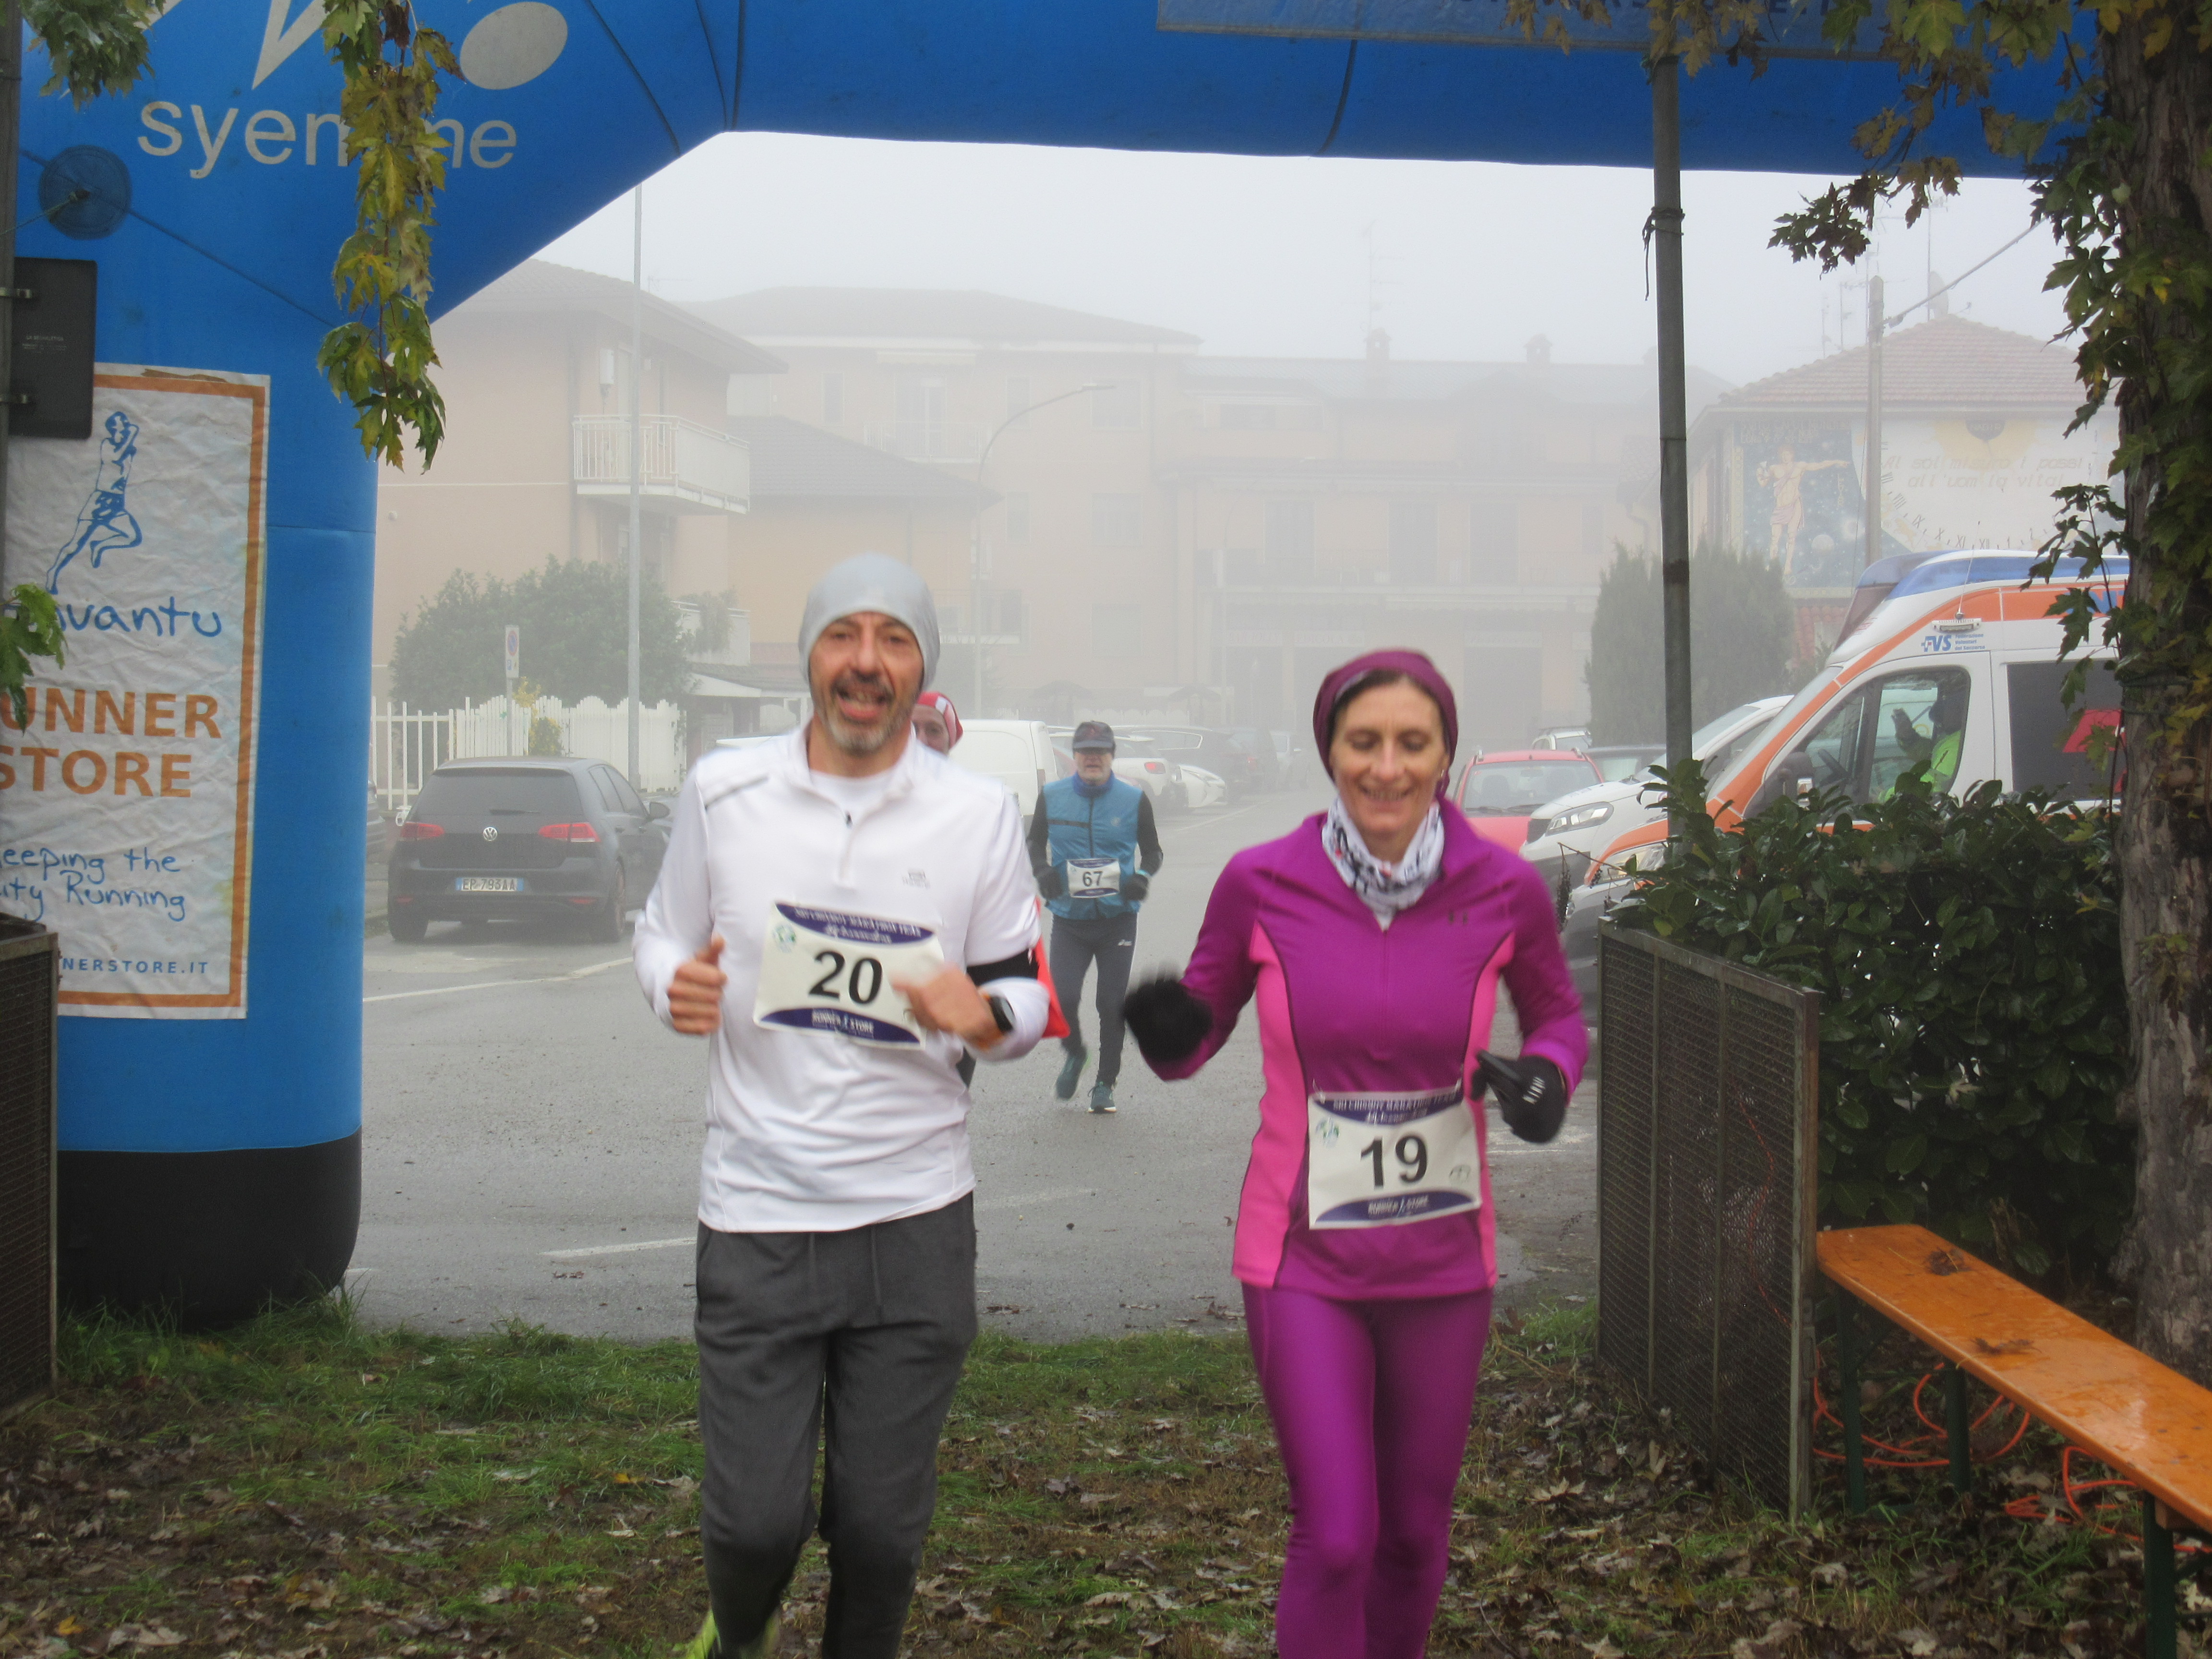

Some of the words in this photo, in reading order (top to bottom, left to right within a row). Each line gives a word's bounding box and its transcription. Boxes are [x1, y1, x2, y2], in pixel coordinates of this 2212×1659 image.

[4, 596, 222, 637] vantu
[1922, 635, 1952, 652] FVS
[0, 847, 105, 885] eeping
[124, 846, 181, 873] the
[1083, 871, 1104, 887] 67
[0, 877, 44, 922] ity
[60, 869, 186, 922] Running
[62, 958, 208, 974] NERSTORE.IT
[808, 950, 883, 1005] 20
[1360, 1134, 1429, 1189] 19
